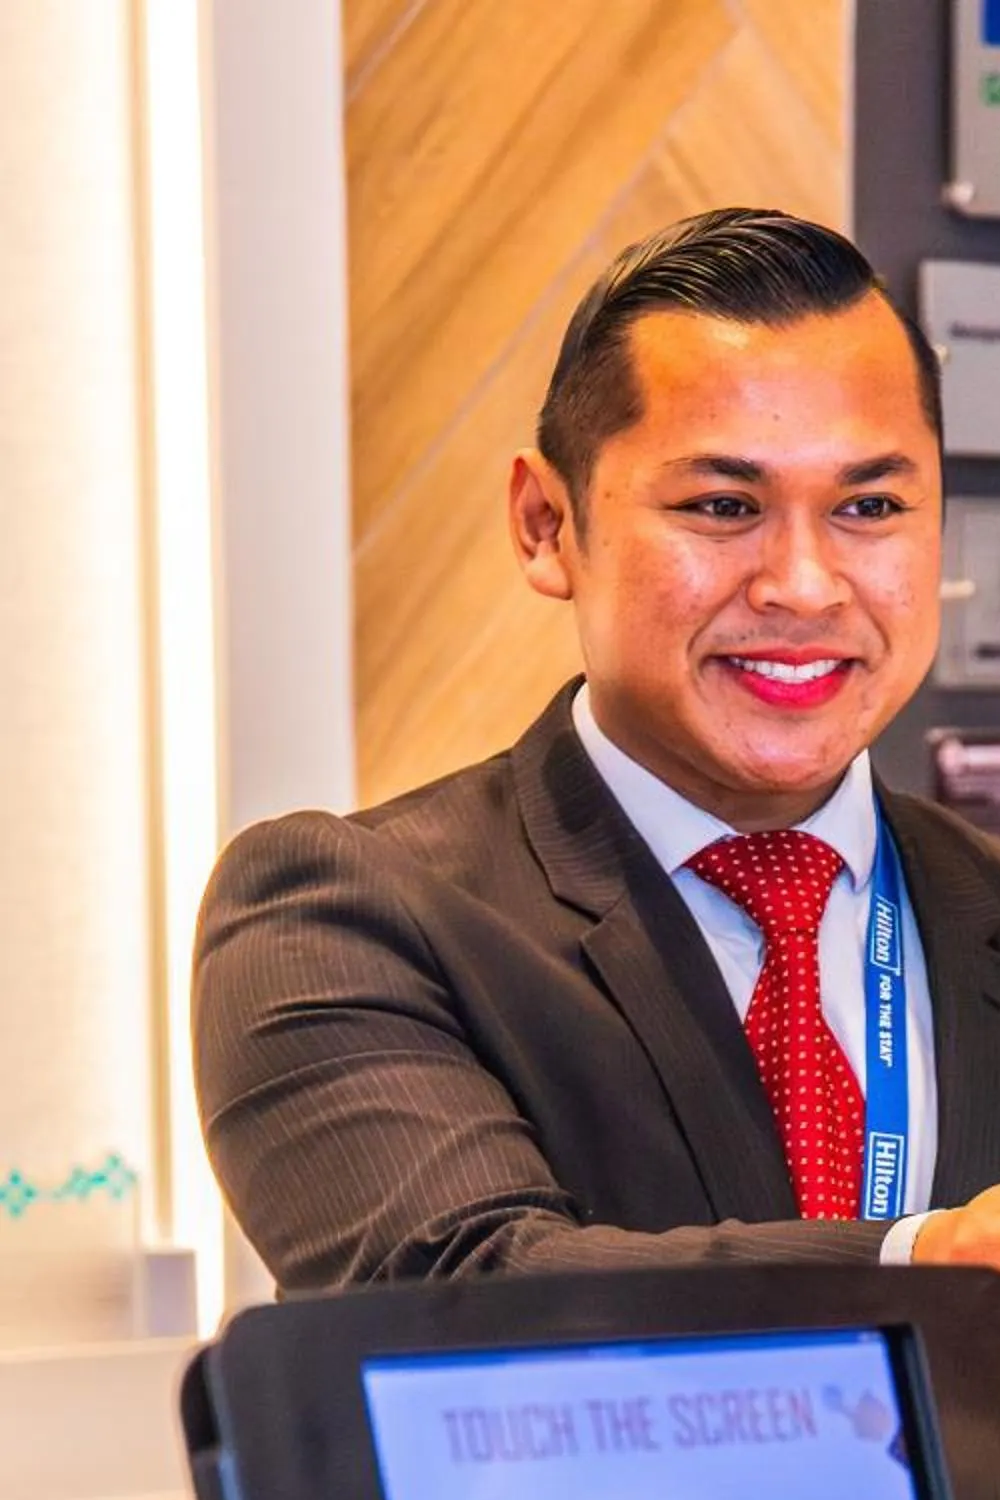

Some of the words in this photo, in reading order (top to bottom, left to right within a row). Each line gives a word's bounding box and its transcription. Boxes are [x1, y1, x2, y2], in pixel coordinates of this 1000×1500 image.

[876, 901, 893, 962] Hilton
[880, 973, 892, 1000] FOR
[879, 1003, 892, 1028] THE
[879, 1031, 893, 1068] STAY
[872, 1140, 896, 1214] Hilton
[442, 1403, 578, 1465] TOUCH
[586, 1396, 660, 1453] THE
[665, 1386, 818, 1449] SCREEN
